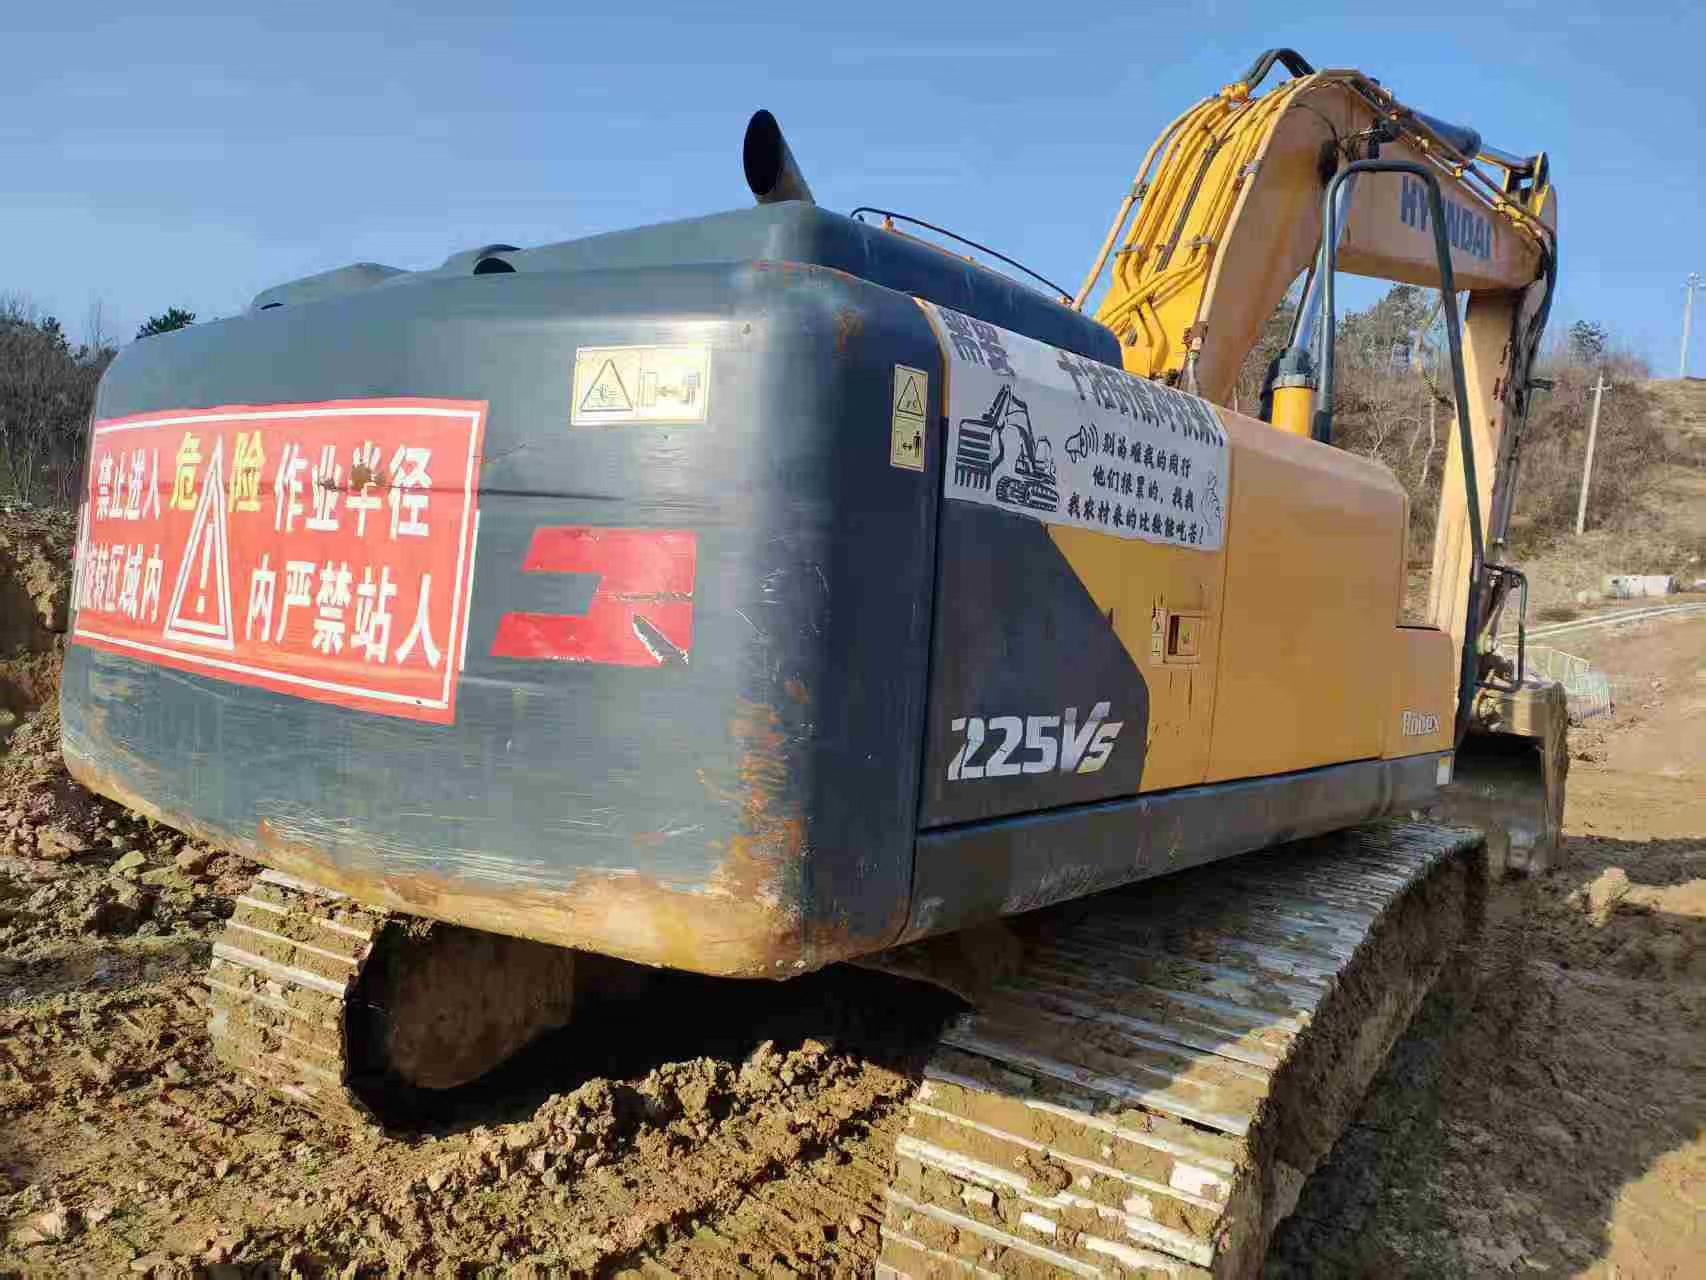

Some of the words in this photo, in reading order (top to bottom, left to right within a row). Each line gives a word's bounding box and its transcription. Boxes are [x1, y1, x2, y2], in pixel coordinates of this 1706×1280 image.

[1401, 175, 1491, 257] HYNDAI
[272, 439, 434, 540] 作业半径
[245, 552, 441, 668] 内严禁站人
